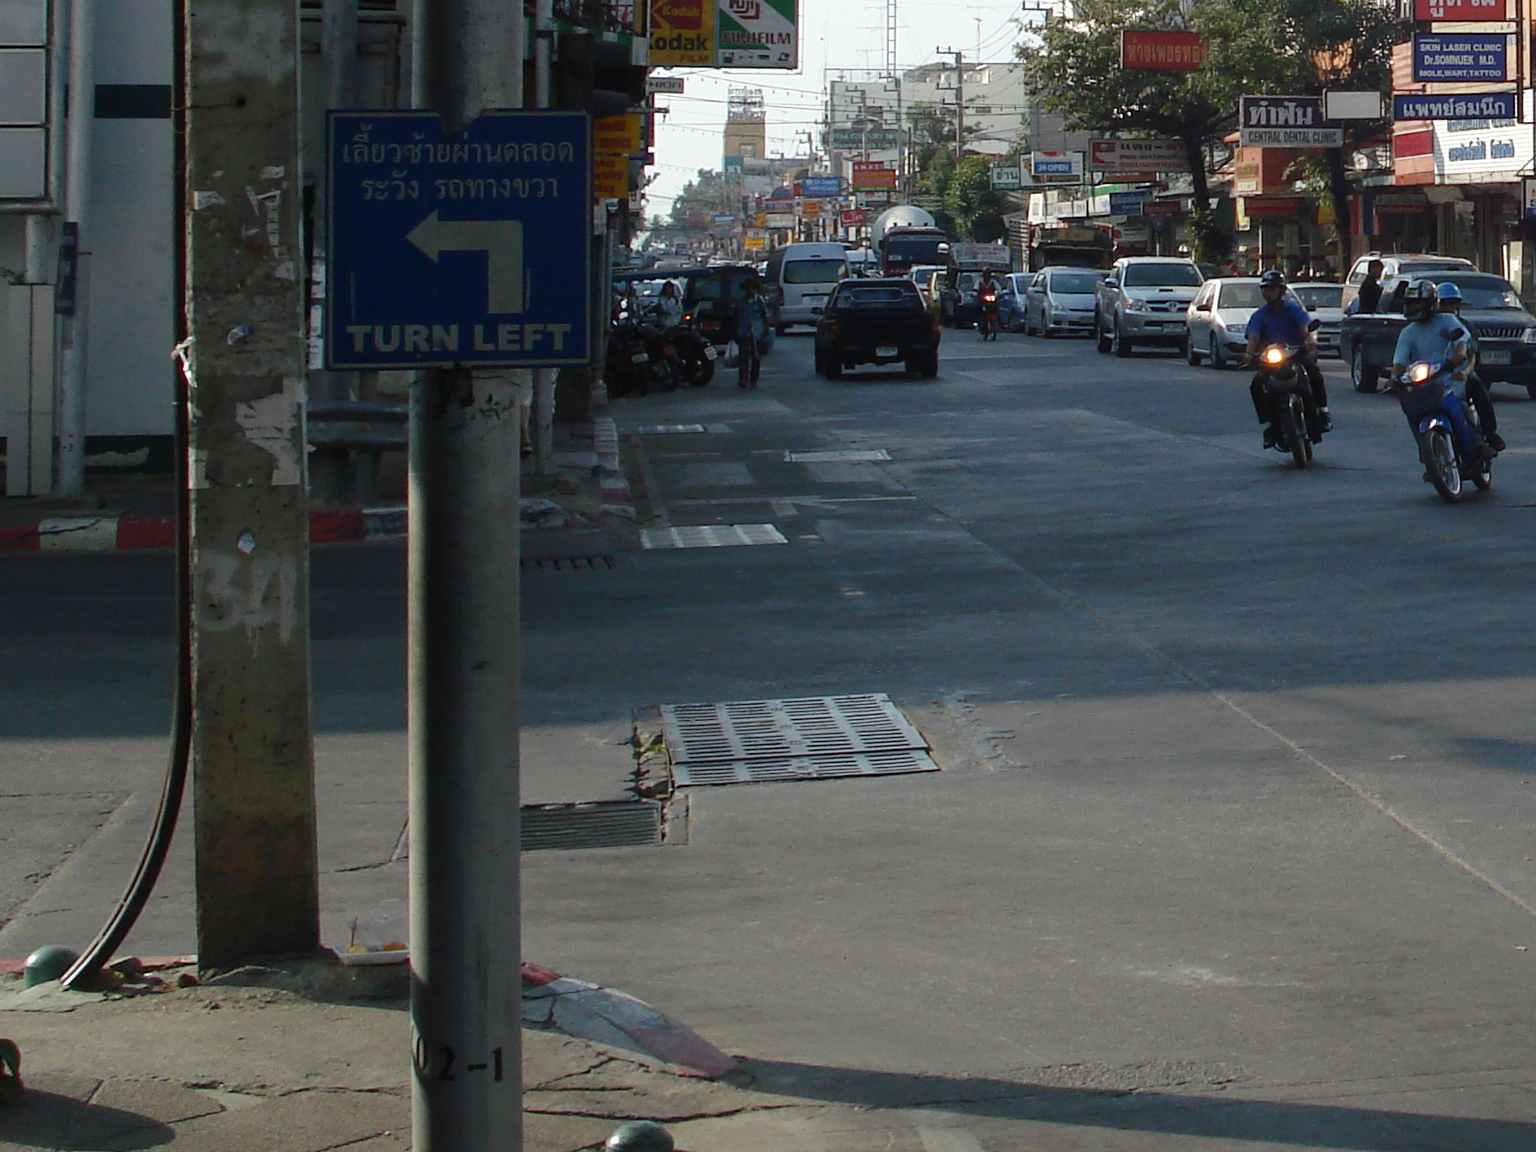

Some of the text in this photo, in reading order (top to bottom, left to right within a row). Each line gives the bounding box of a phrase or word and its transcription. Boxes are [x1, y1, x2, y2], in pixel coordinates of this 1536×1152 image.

[662, 4, 700, 17] Kodak
[721, 30, 791, 45] FUJIFILM
[1419, 43, 1502, 52] SKIN LASER CLINIC
[679, 54, 709, 63] FILM
[1249, 100, 1313, 126] ทำฟัน
[1403, 97, 1506, 117] แพทย์สมนึก
[1249, 130, 1337, 143] CENTRAL DENTAL CLINIC
[361, 169, 558, 200] ระวัง รถทางขวา
[346, 323, 571, 352] TURN LEFT
